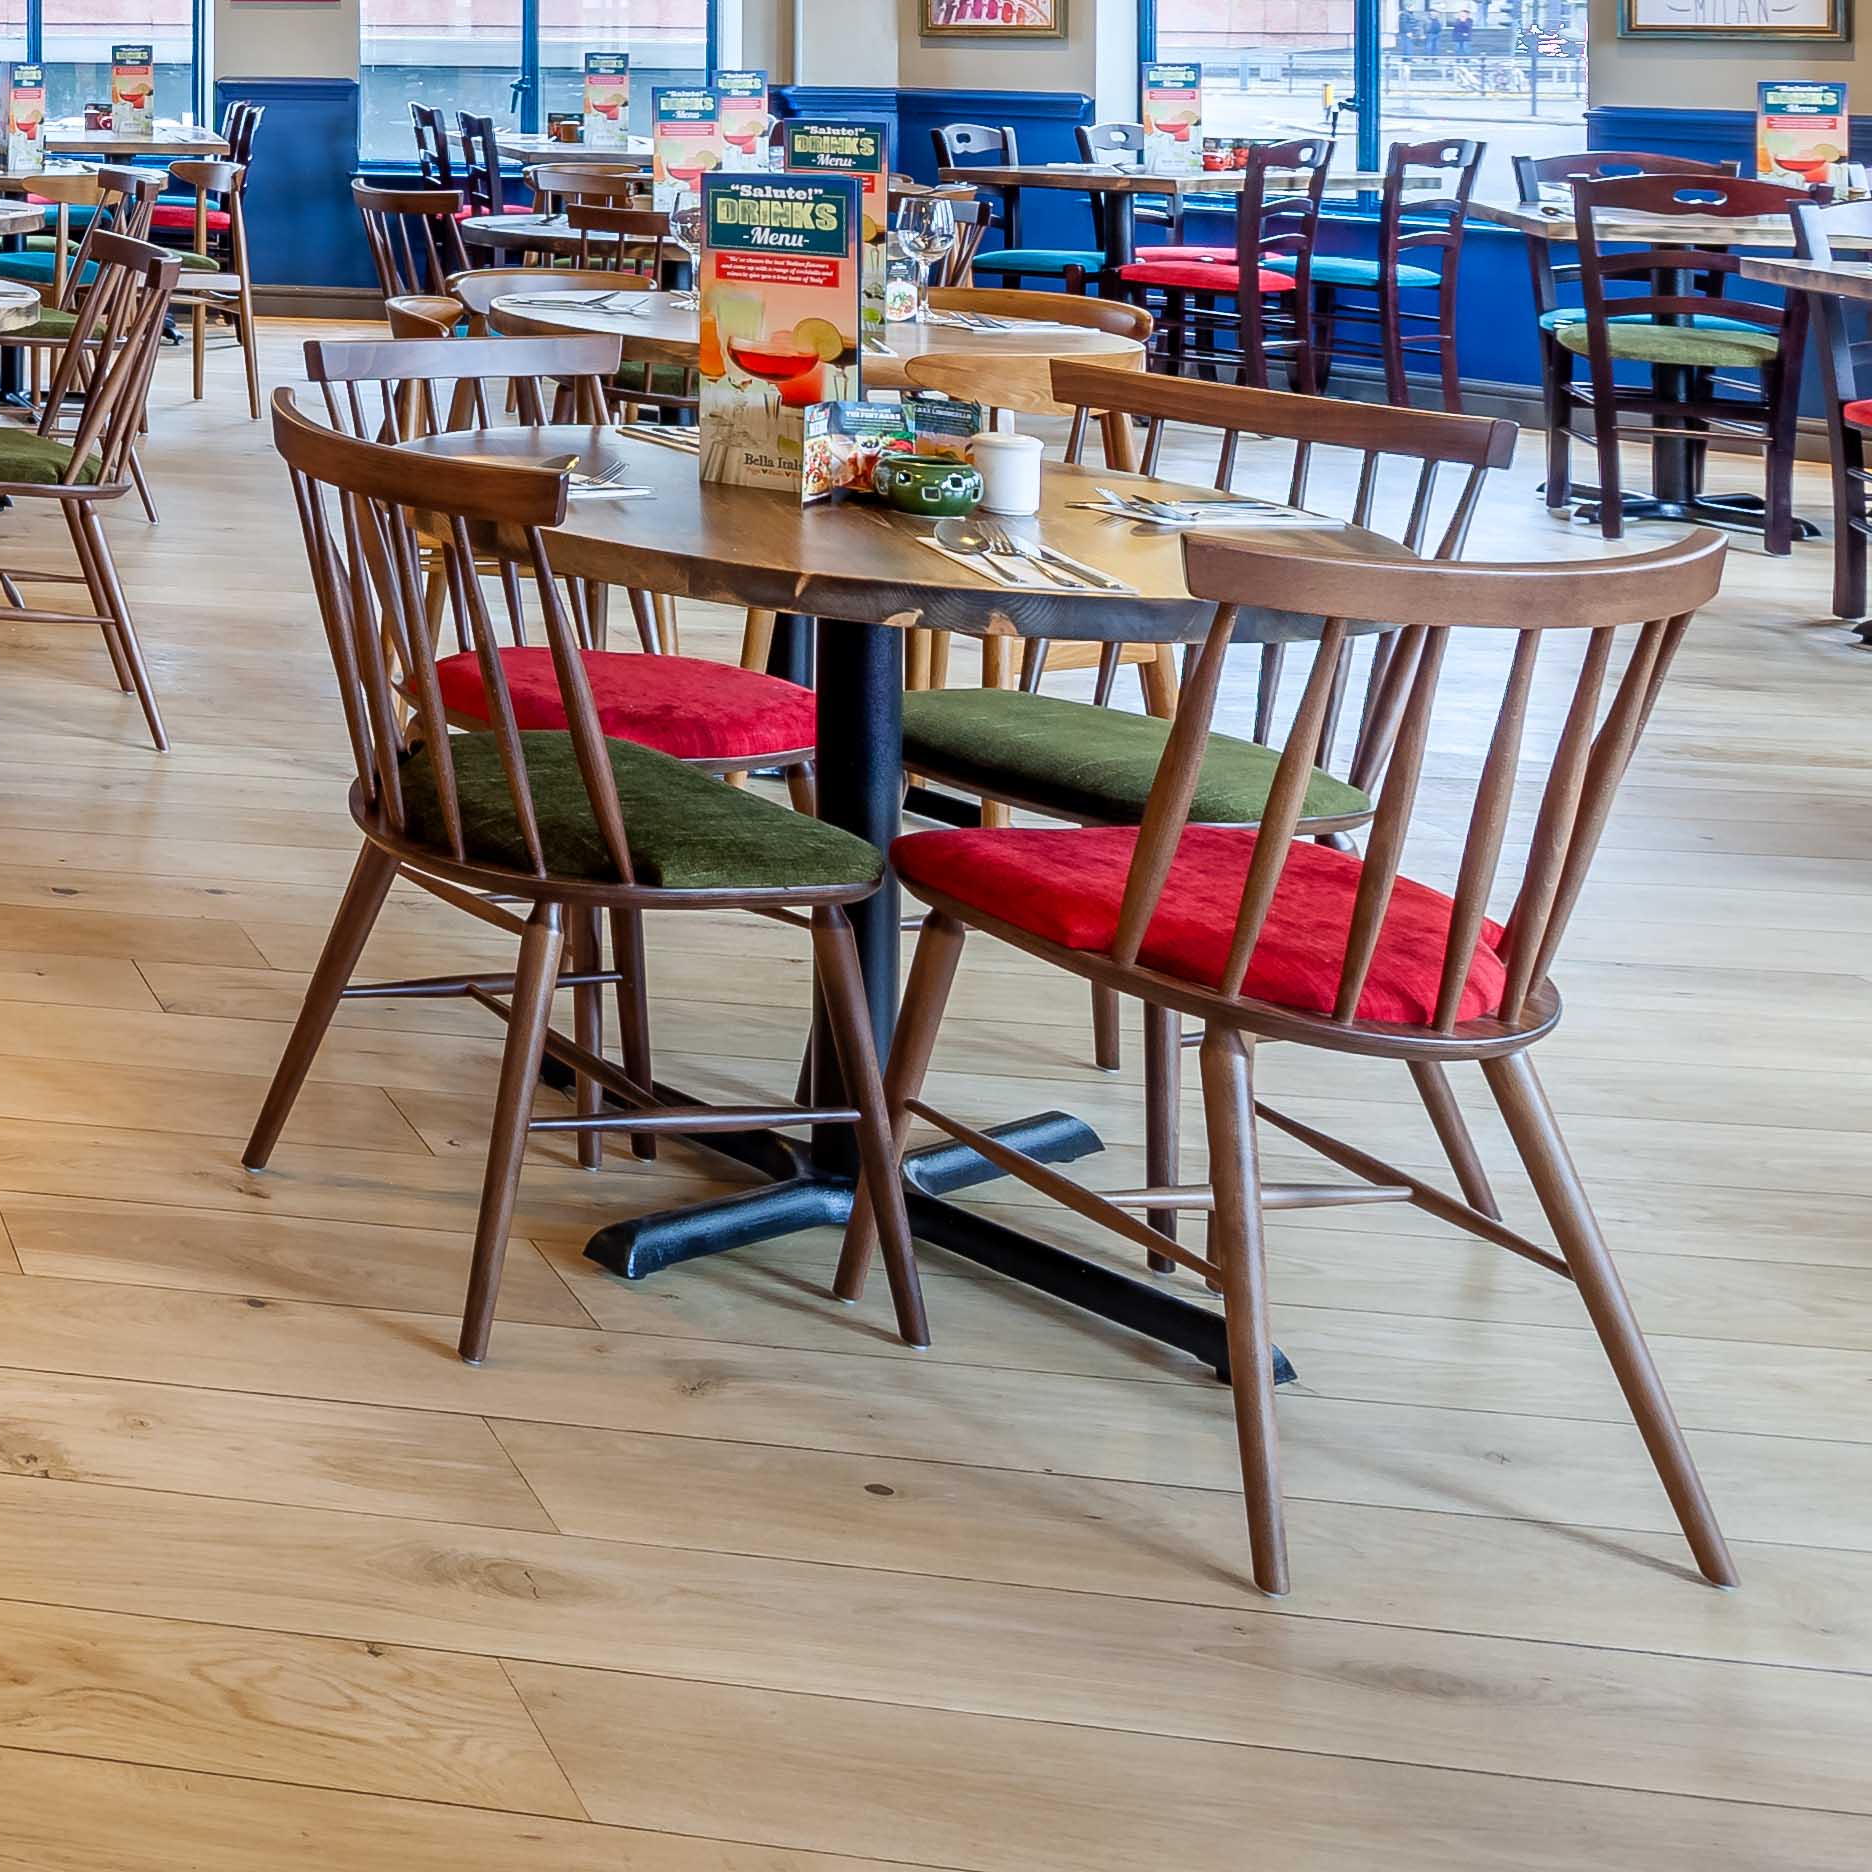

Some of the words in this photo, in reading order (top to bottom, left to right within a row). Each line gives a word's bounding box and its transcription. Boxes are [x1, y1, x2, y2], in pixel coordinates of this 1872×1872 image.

[794, 135, 875, 156] DRINKS
[717, 197, 838, 231] DRINKS
[744, 453, 775, 468] Bella
